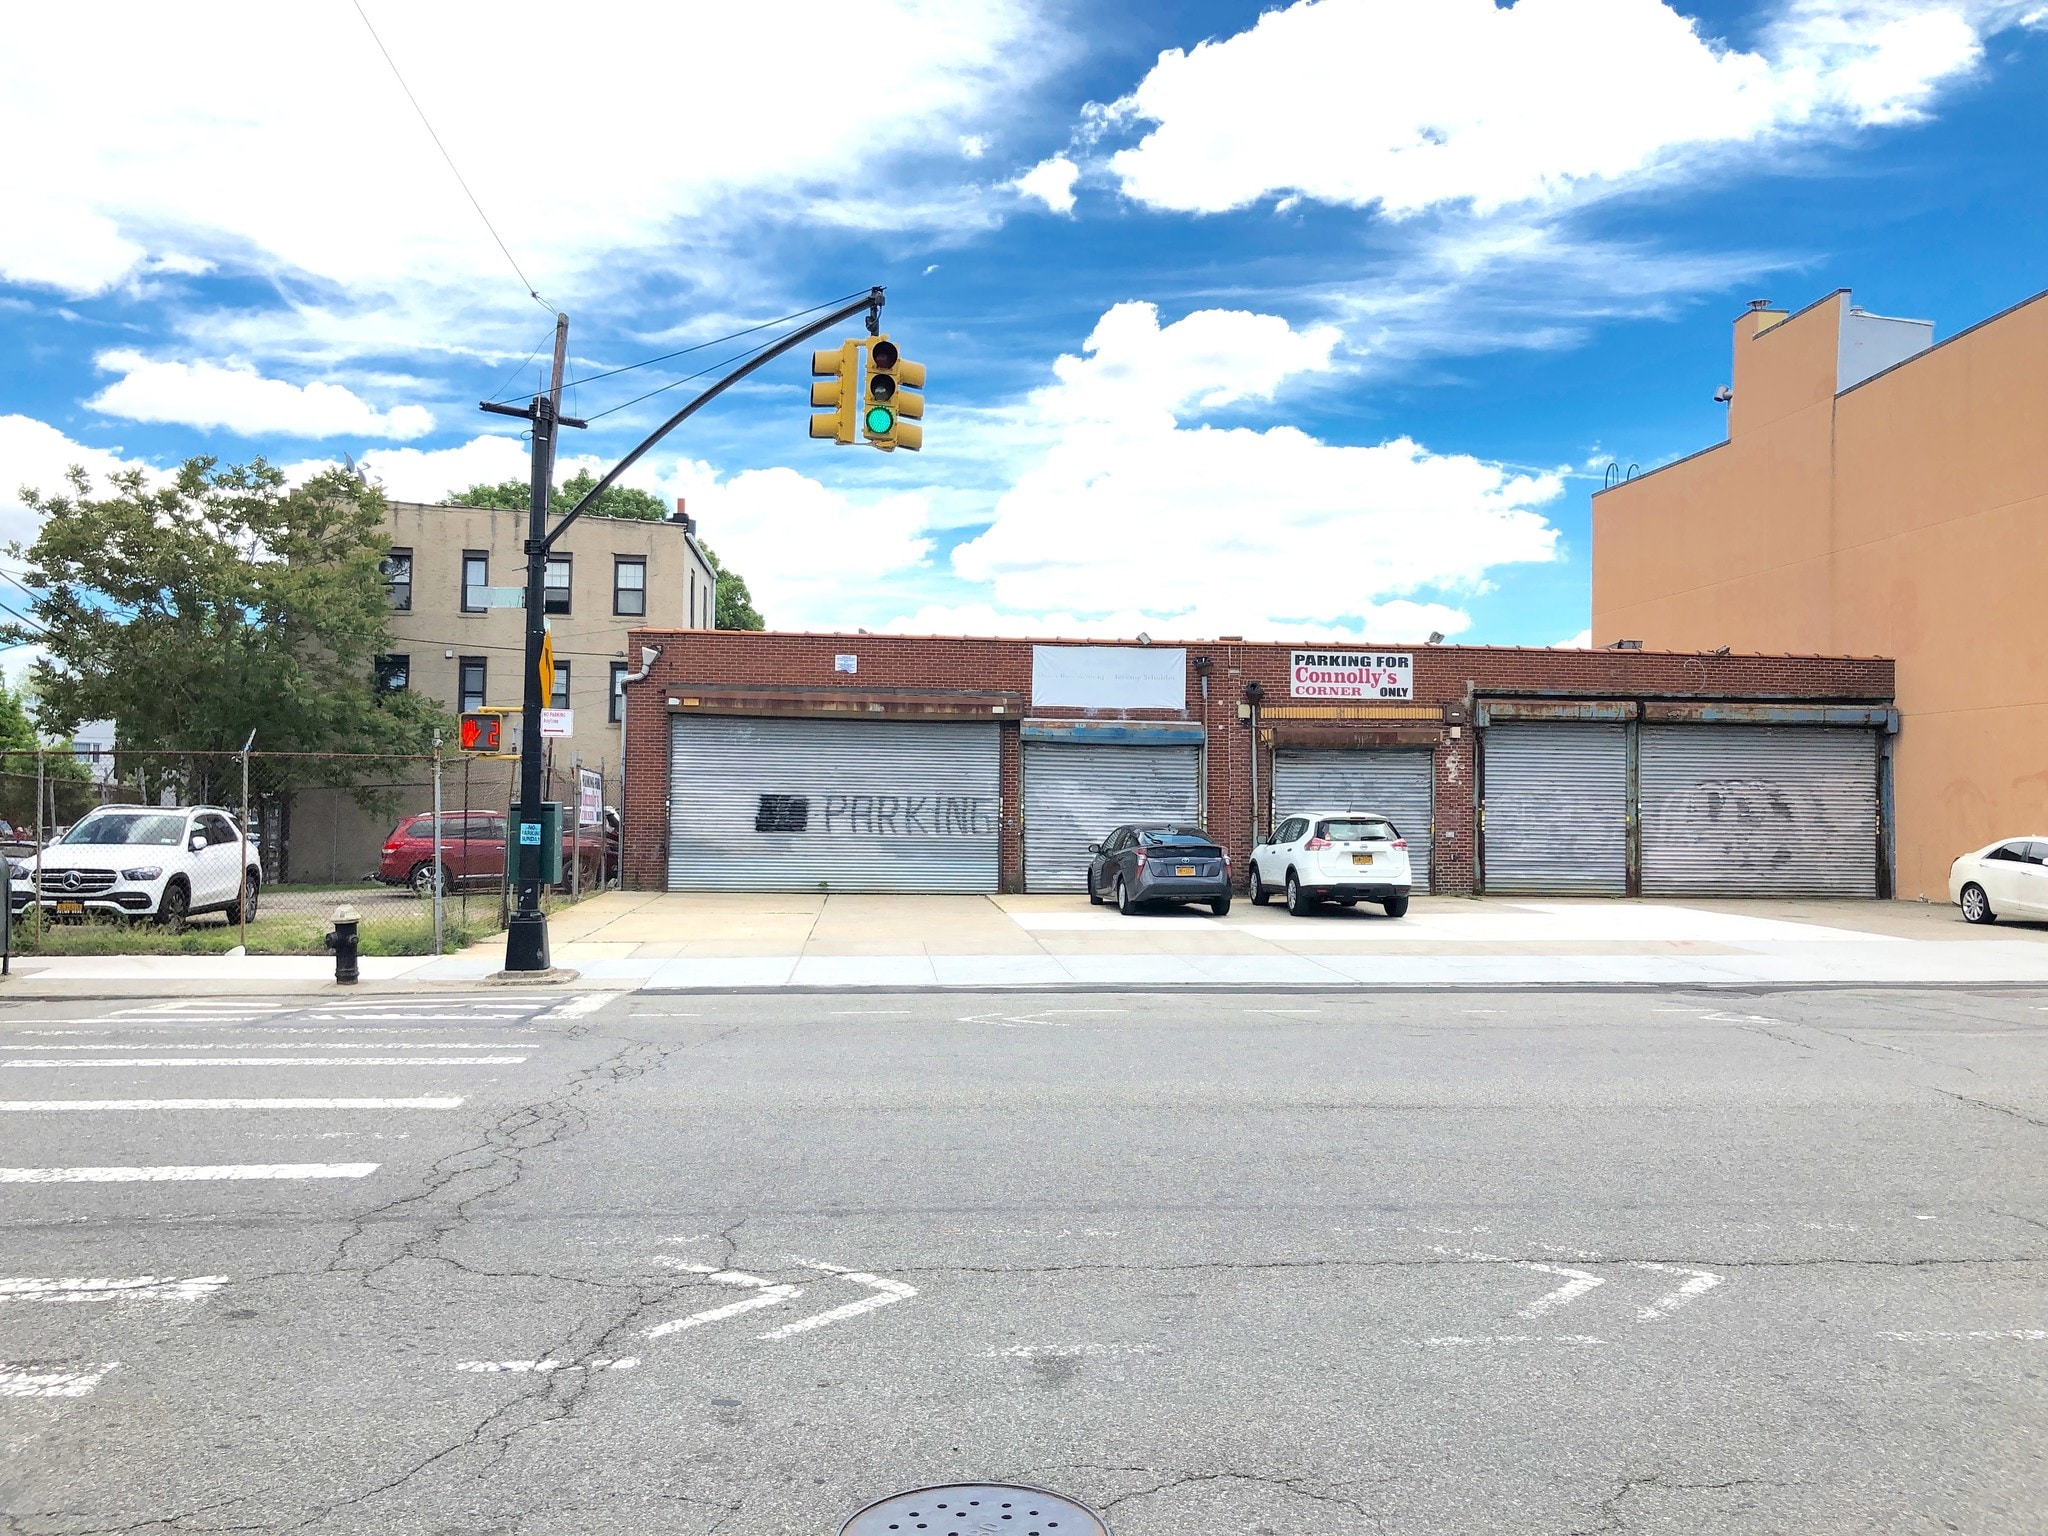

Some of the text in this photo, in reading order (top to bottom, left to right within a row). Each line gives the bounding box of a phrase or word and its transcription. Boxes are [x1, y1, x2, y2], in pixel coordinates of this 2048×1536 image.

[1294, 654, 1409, 668] PARKING FOR
[1295, 666, 1398, 689] Connolly's
[1295, 686, 1409, 697] CORNER ONLY
[488, 721, 499, 746] 2
[824, 794, 996, 836] PARKING
